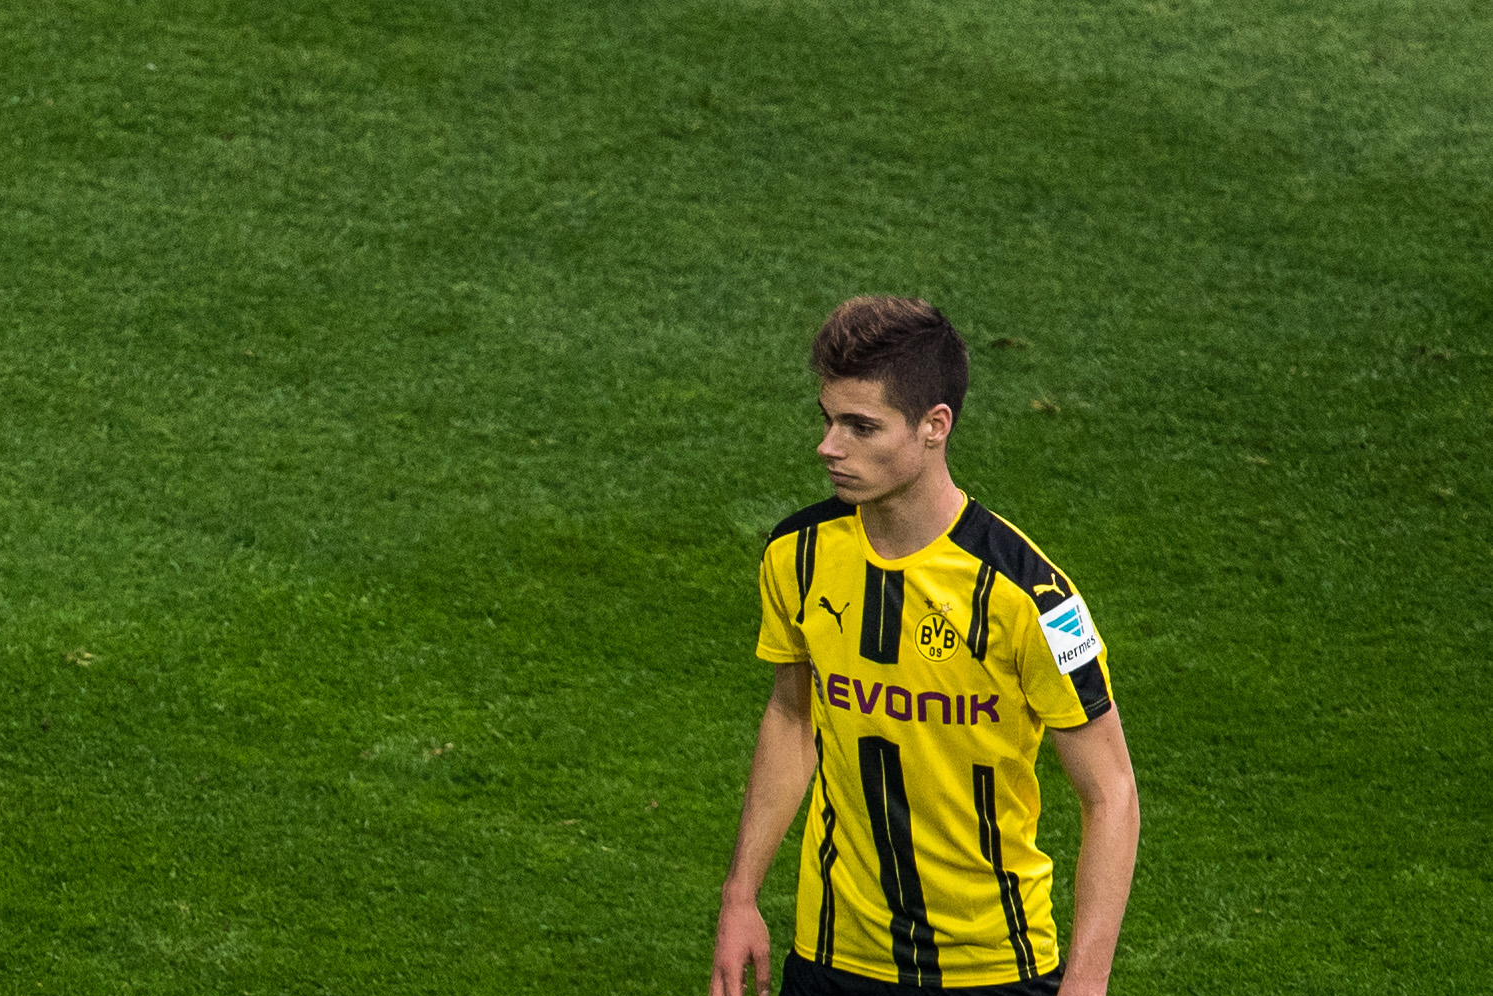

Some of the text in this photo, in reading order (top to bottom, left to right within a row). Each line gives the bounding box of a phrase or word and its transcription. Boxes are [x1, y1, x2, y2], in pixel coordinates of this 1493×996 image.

[921, 616, 956, 649] BVB
[929, 646, 942, 658] 09
[1058, 635, 1096, 666] Hermes
[827, 673, 1000, 725] EVONIK
